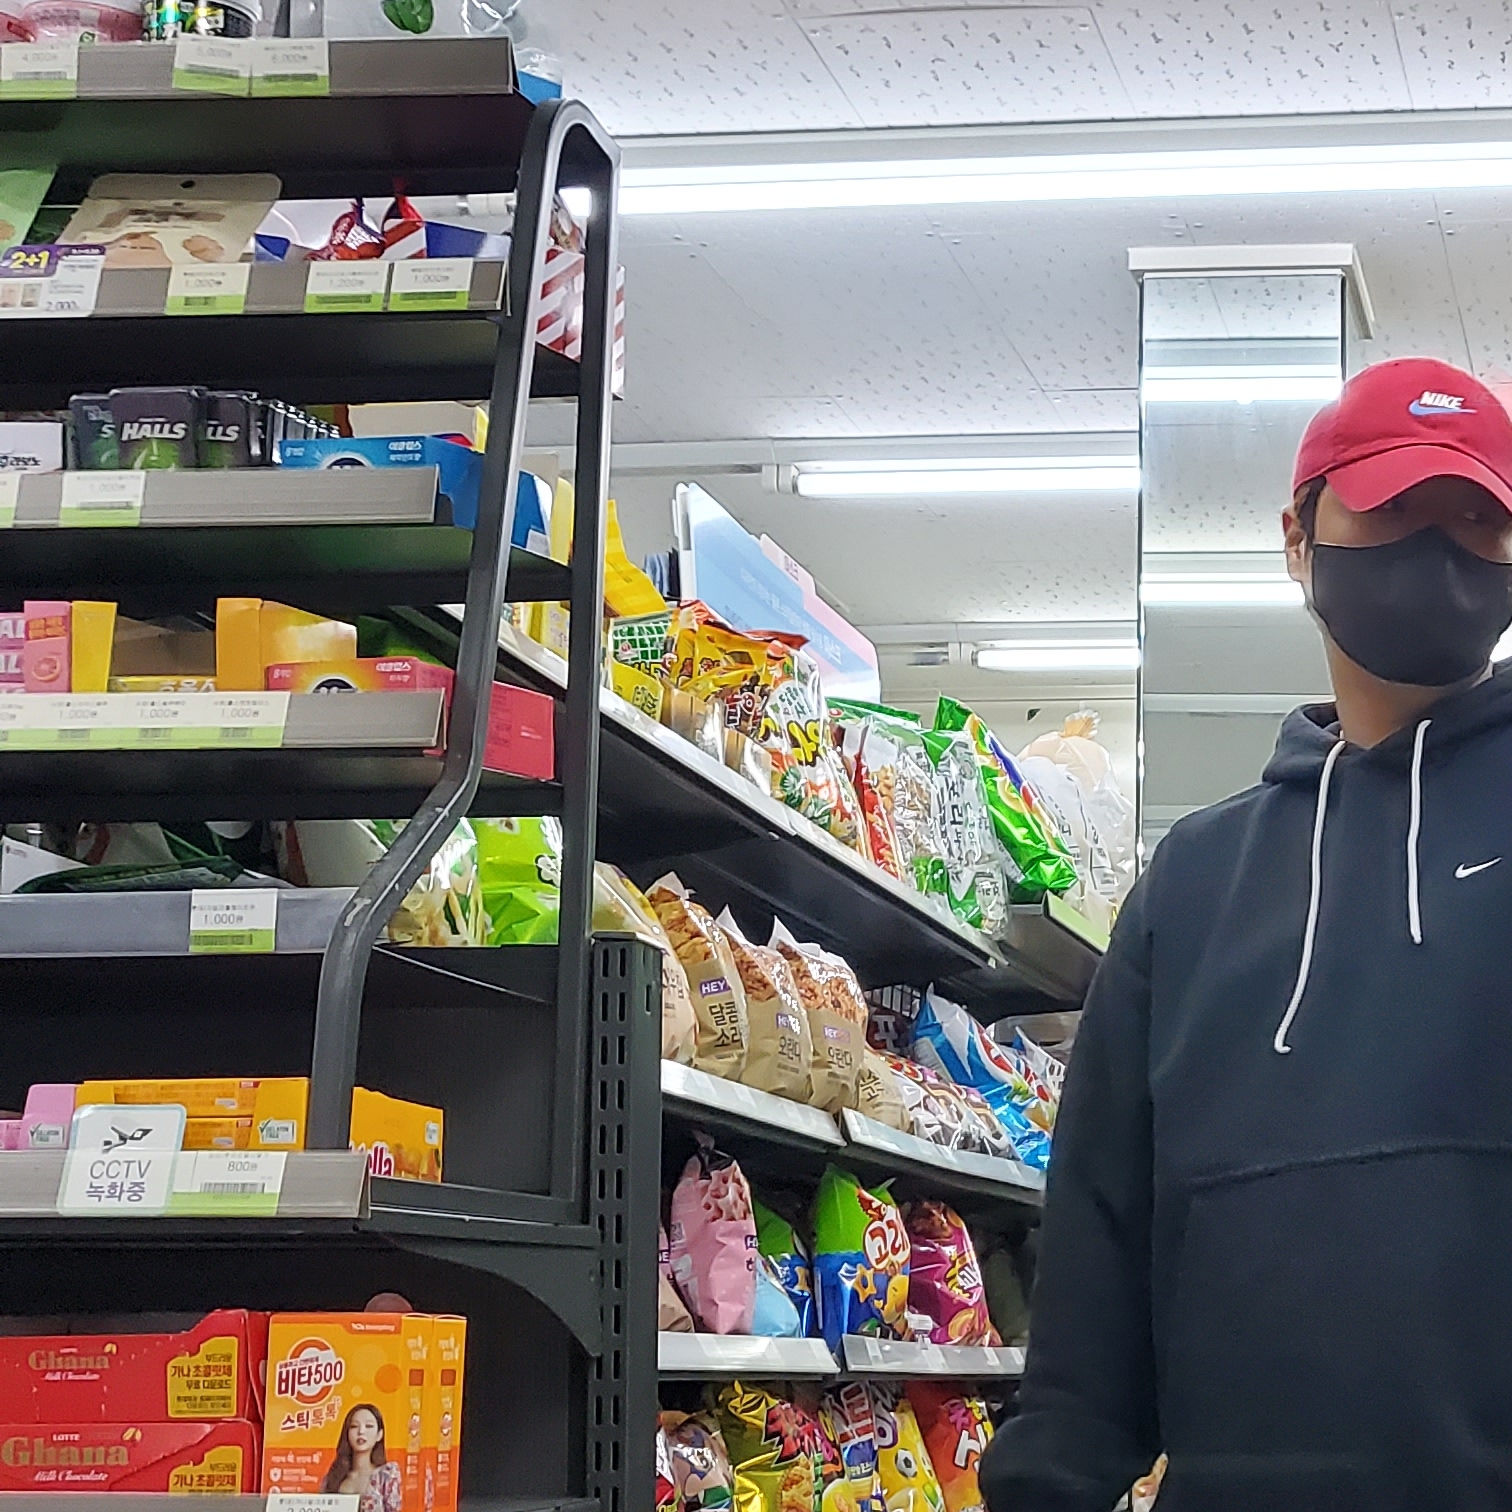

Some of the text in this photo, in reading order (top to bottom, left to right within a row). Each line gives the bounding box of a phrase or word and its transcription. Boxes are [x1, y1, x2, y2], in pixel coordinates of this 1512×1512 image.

[12, 252, 50, 269] 2+1
[1420, 391, 1464, 409] NIKE
[121, 421, 189, 442] HALLS
[206, 423, 241, 442] LLS
[90, 1160, 151, 1179] CCTV
[86, 1182, 146, 1203] 녹화중
[28, 1350, 110, 1370] Ghana
[277, 1360, 343, 1397] 비타500
[53, 1433, 80, 1441] LOTTE
[1, 1437, 130, 1467] Ghana
